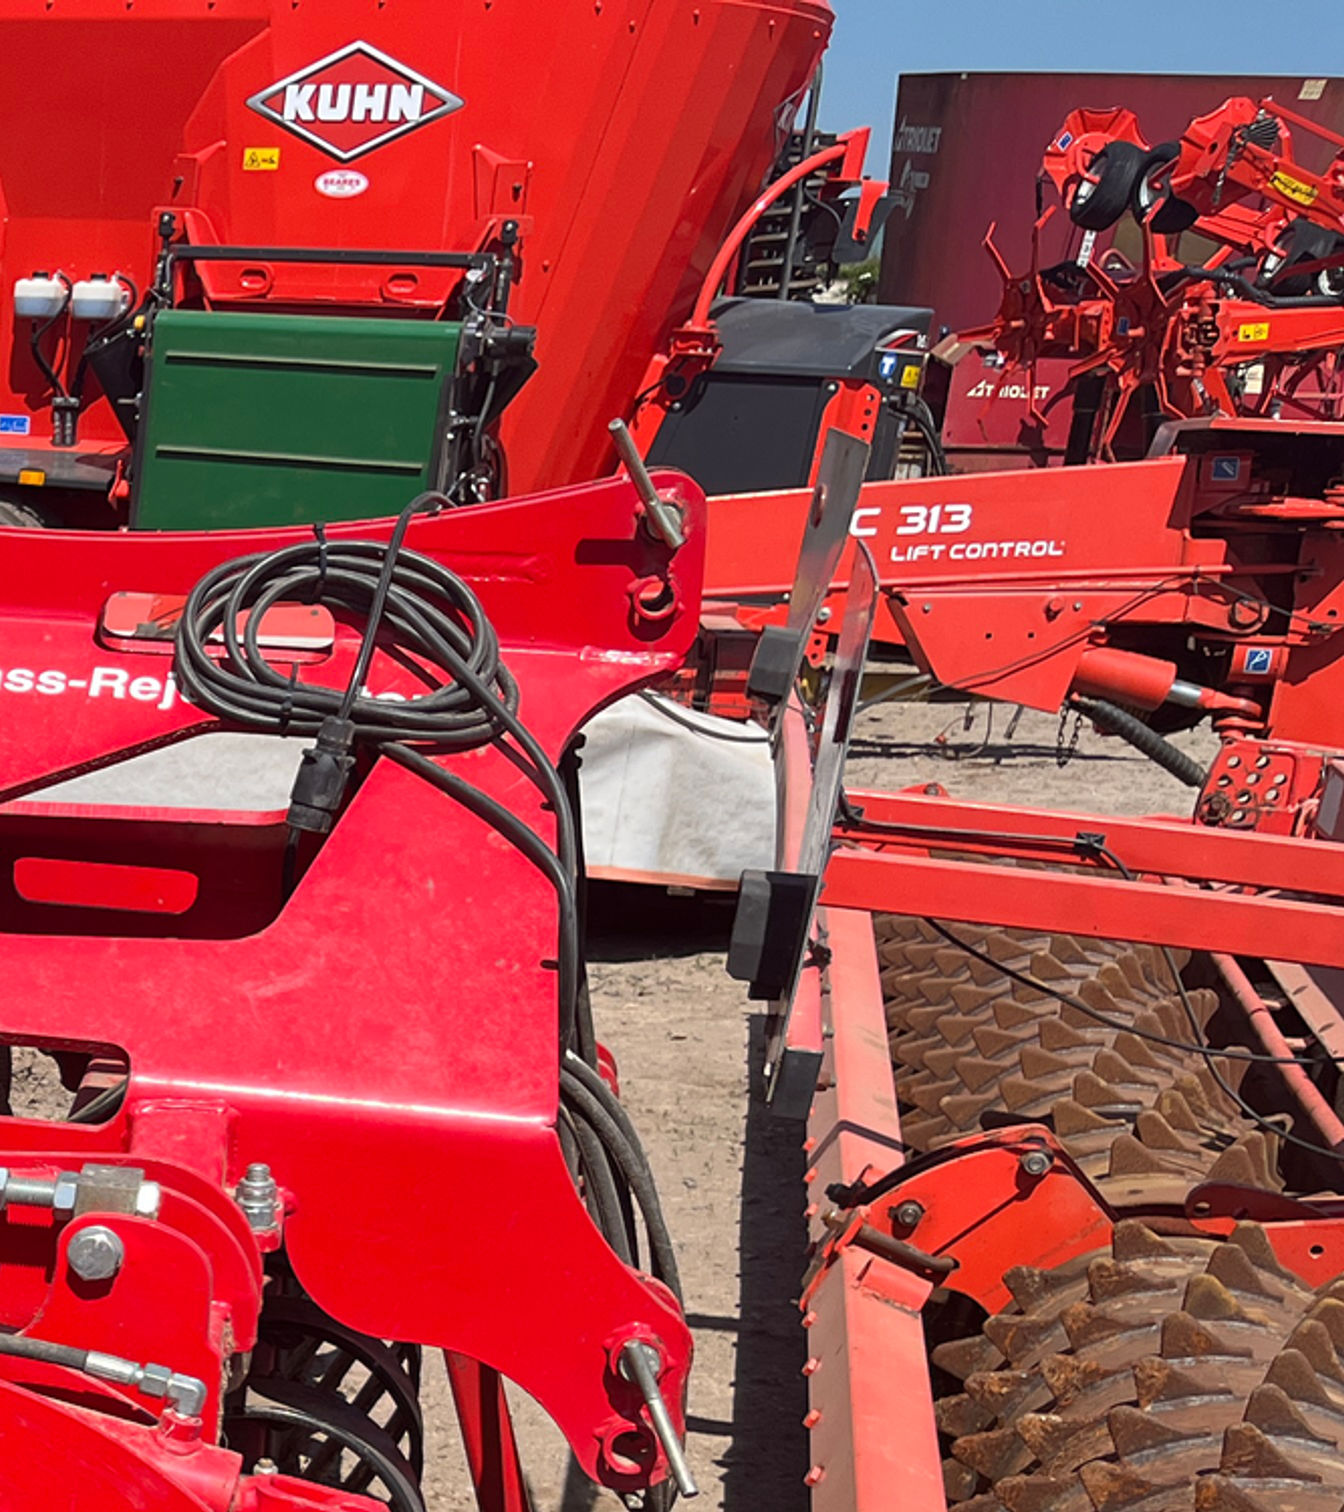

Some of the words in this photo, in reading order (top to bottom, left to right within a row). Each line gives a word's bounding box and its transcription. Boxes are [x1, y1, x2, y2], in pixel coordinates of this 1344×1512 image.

[282, 83, 425, 123] KUHN
[896, 503, 973, 535] 313
[890, 545, 946, 561] LIFT
[948, 540, 1063, 559] CONTROL
